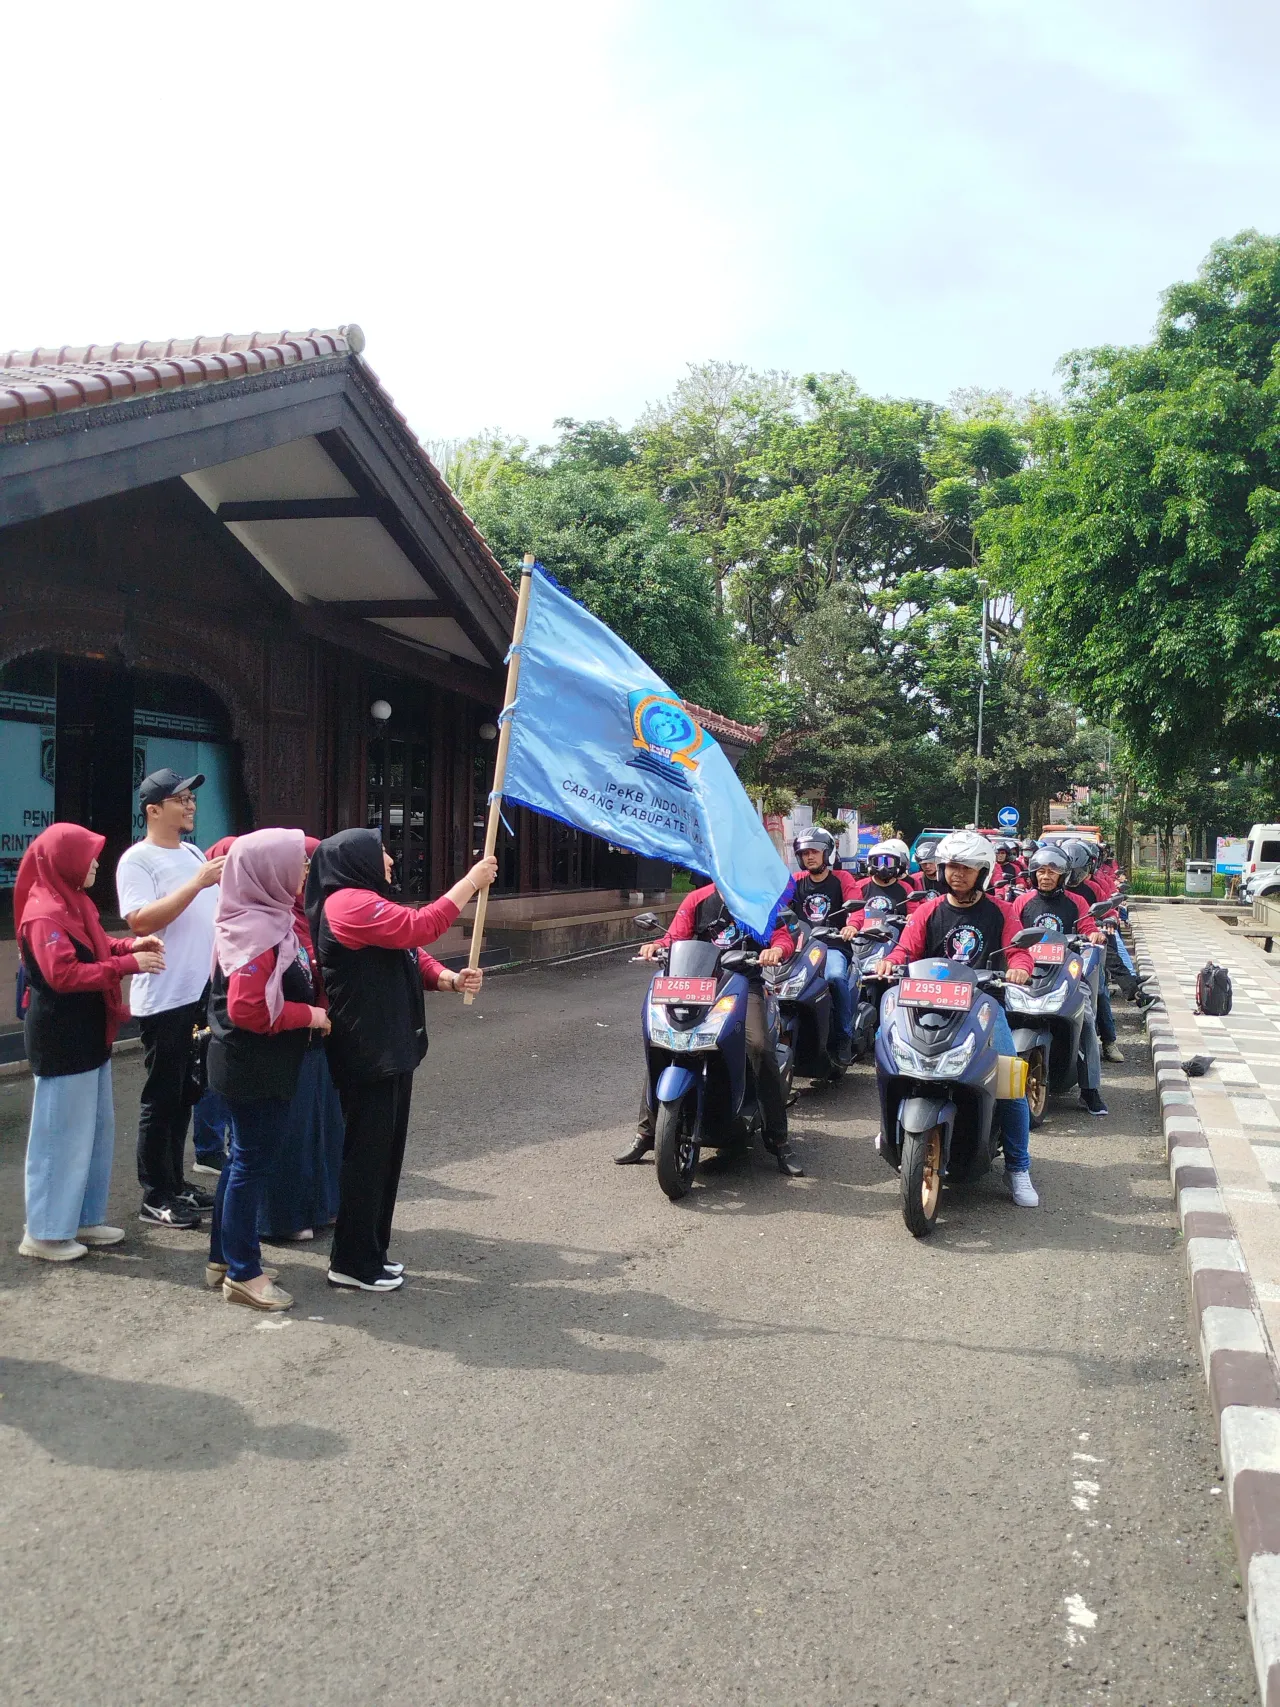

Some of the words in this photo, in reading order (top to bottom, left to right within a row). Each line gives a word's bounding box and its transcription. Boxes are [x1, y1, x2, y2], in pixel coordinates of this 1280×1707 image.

[562, 780, 614, 810] CABANG
[605, 782, 644, 803] IPeKB
[23, 809, 54, 827] PEN
[1051, 945, 1062, 954] EP
[656, 980, 663, 990] N
[667, 980, 690, 990] 2466
[700, 981, 713, 991] EP
[903, 982, 911, 992] N
[915, 983, 942, 994] 2959
[954, 985, 968, 996] EP
